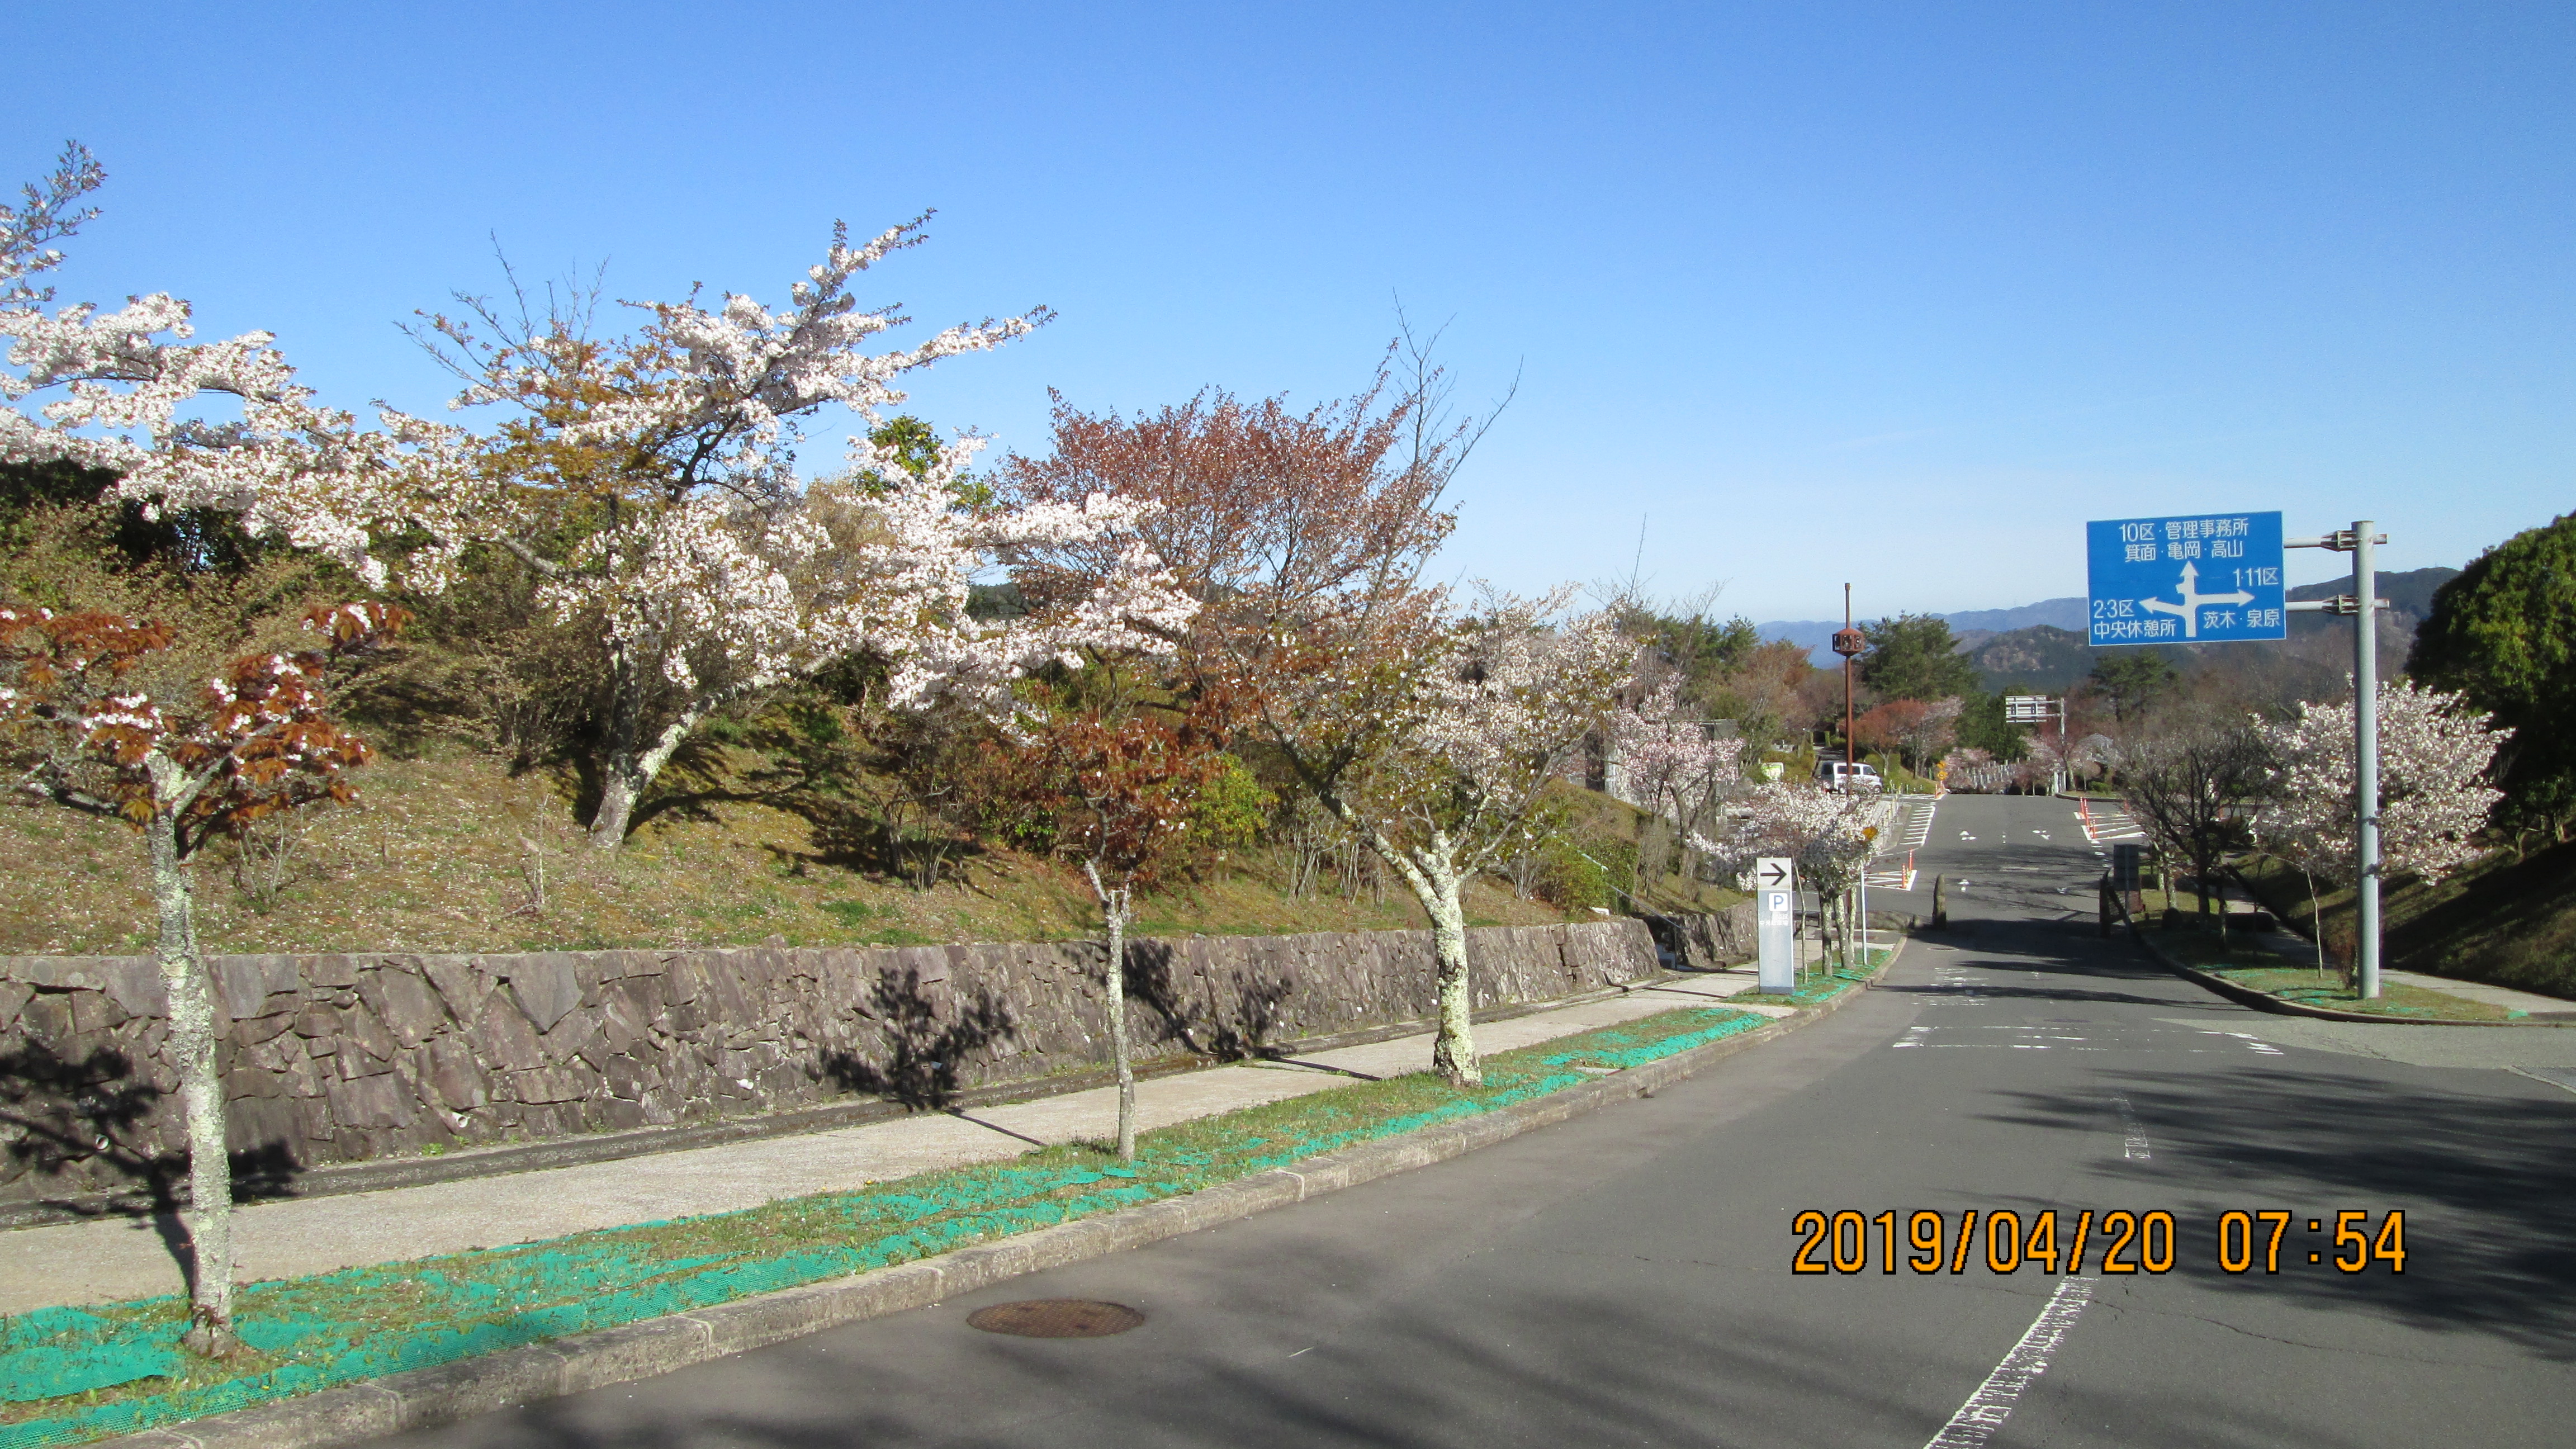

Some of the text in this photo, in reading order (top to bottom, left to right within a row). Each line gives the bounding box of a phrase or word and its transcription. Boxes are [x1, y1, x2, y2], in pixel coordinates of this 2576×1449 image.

[2094, 619, 2176, 640] 中央休憩所
[1774, 895, 1784, 910] P
